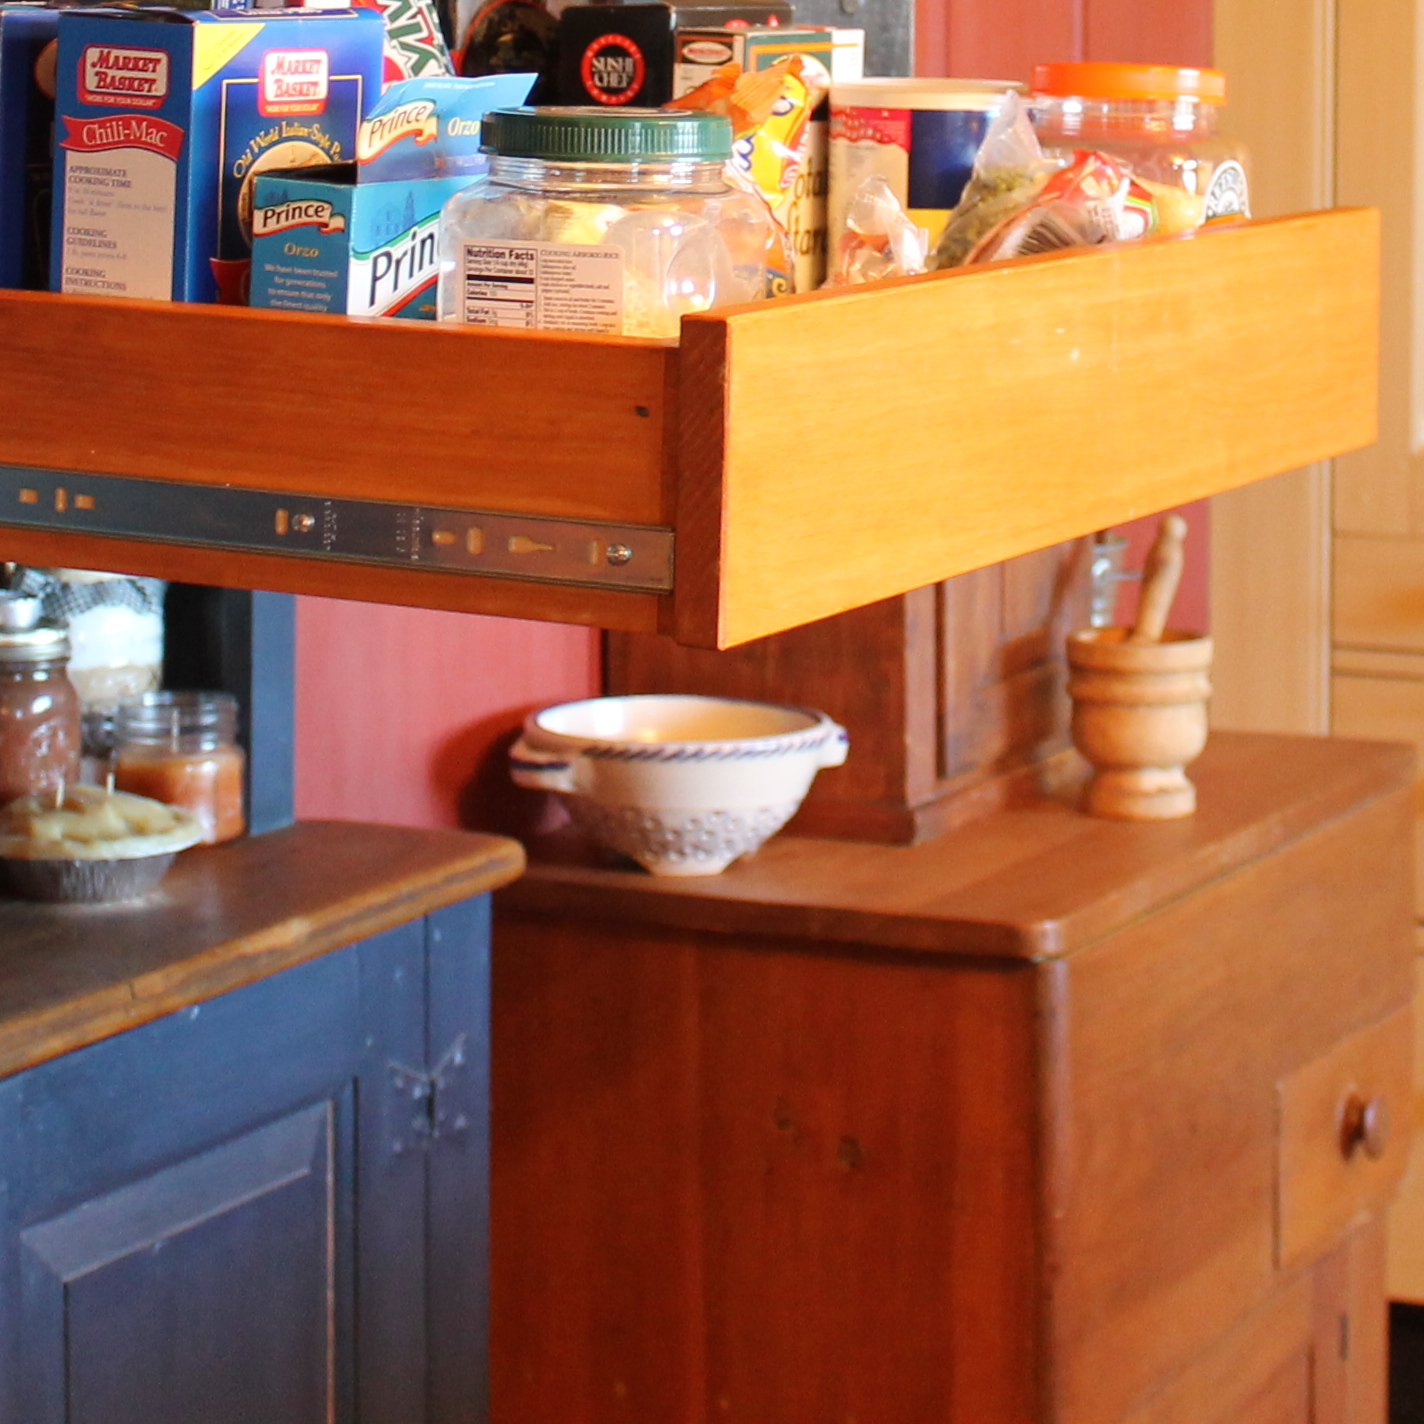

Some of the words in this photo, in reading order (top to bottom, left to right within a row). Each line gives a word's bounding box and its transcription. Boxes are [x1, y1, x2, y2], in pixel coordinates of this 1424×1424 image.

[91, 50, 162, 73] MARKET
[271, 56, 323, 75] MARKET
[94, 71, 157, 93] BASKET
[273, 79, 319, 98] BASKET
[82, 120, 168, 148] Chili-Mac
[369, 106, 427, 148] Prince
[448, 117, 480, 136] Orzo
[233, 150, 253, 178] Old
[111, 177, 132, 188] TIME
[262, 203, 325, 228] Prince
[283, 242, 320, 257] Orzo
[467, 248, 505, 259] Nutrition
[509, 249, 534, 260] Facts
